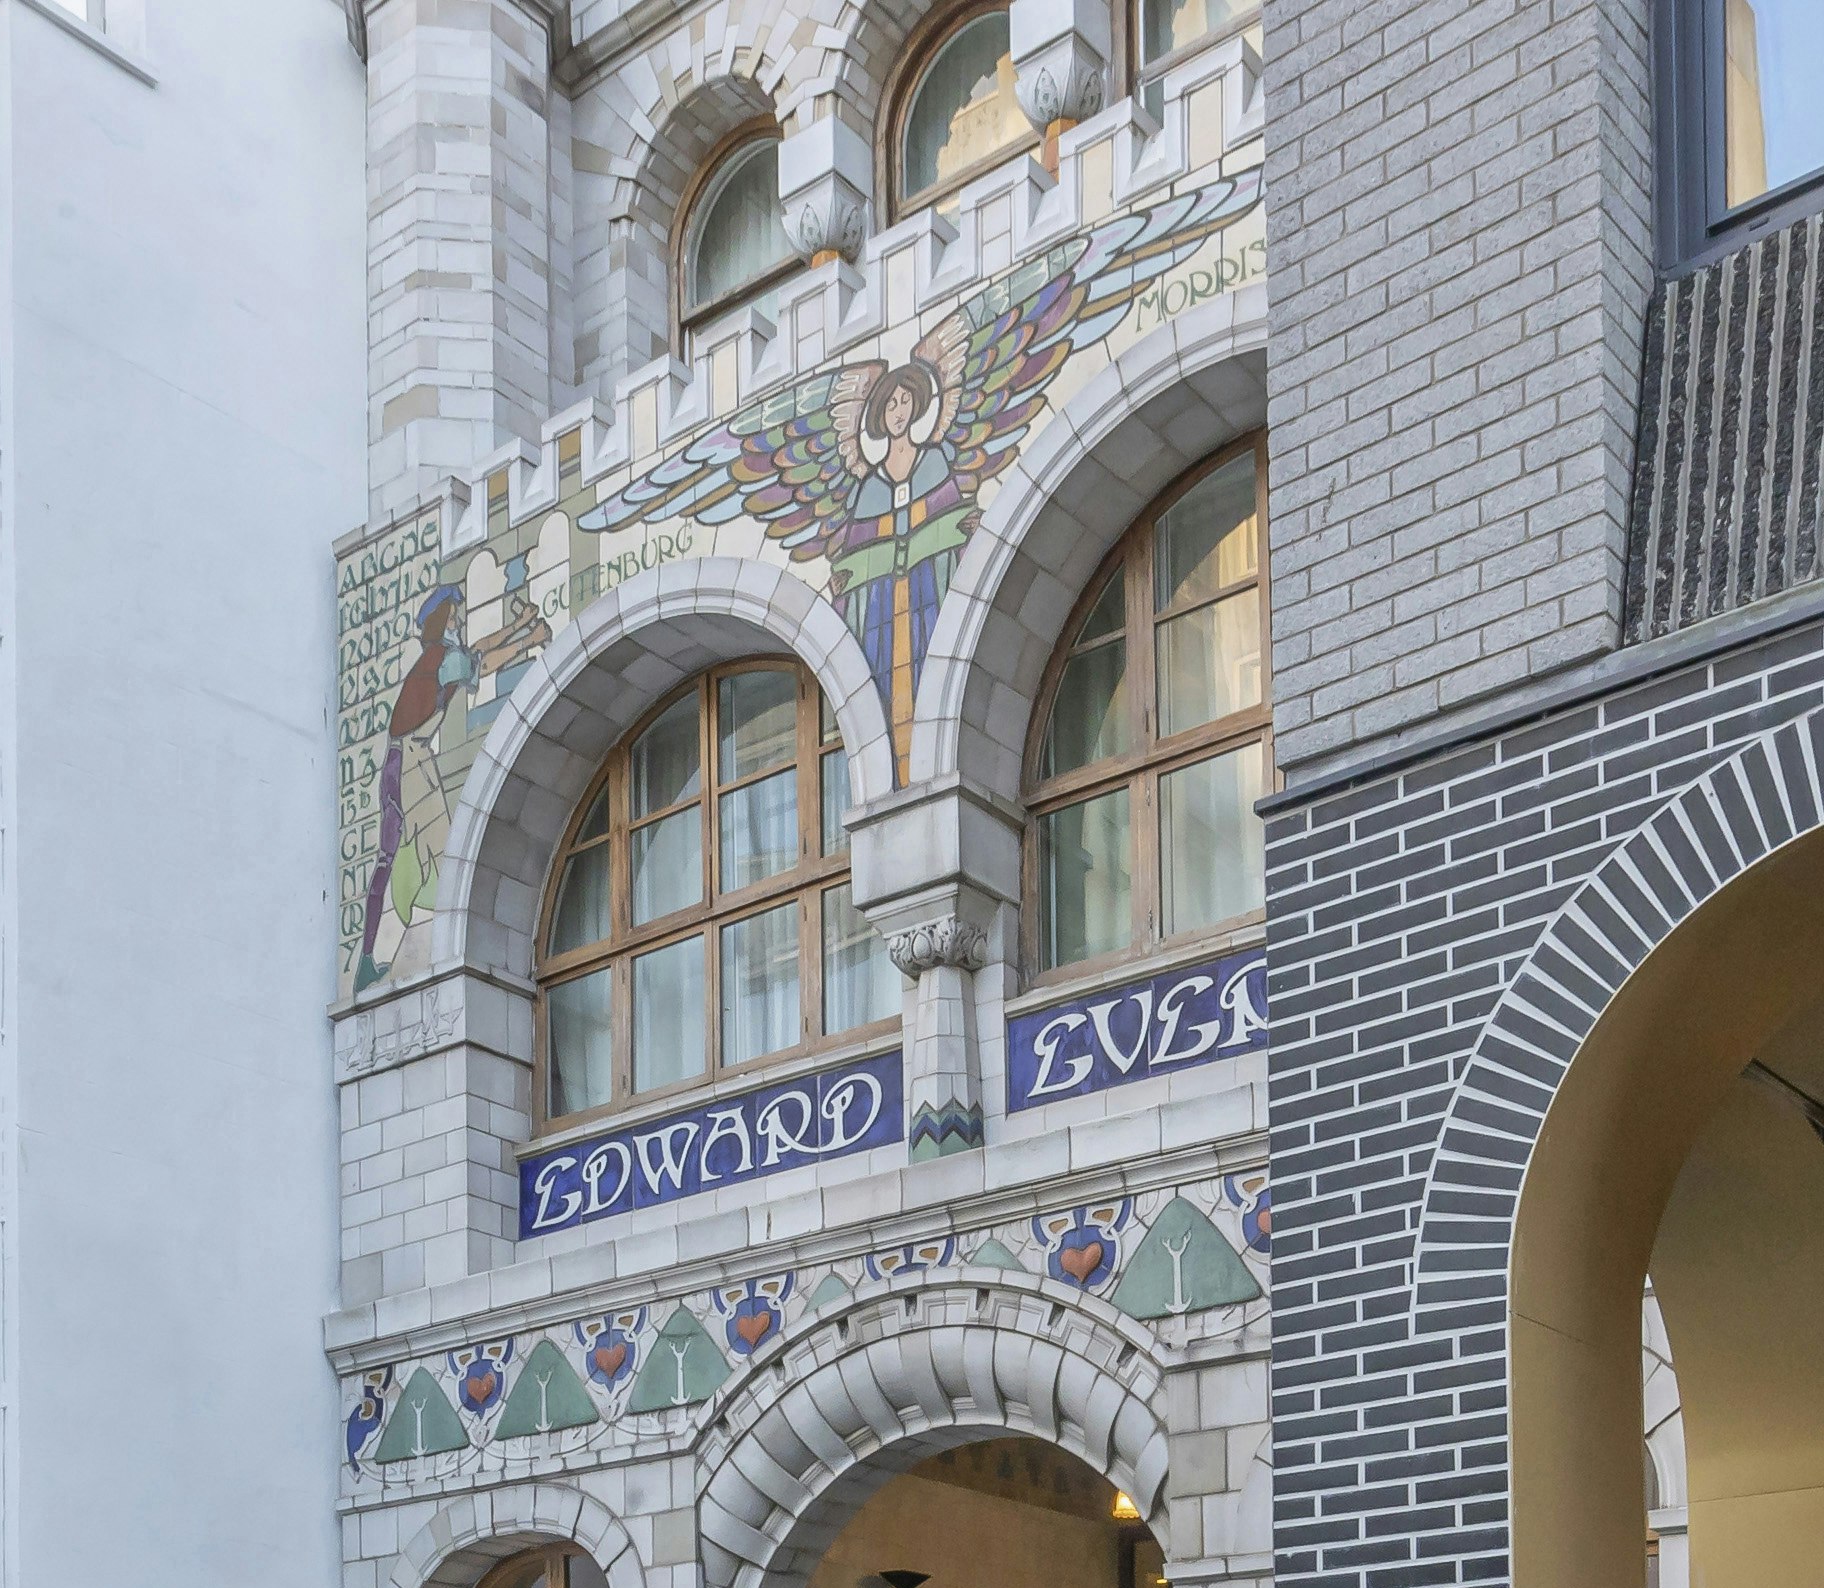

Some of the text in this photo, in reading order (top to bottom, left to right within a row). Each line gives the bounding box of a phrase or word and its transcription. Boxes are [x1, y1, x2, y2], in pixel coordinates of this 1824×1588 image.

[1136, 237, 1267, 333] MORRIS
[542, 521, 693, 618] GUTENBURG
[531, 1072, 883, 1229] EDWARD
